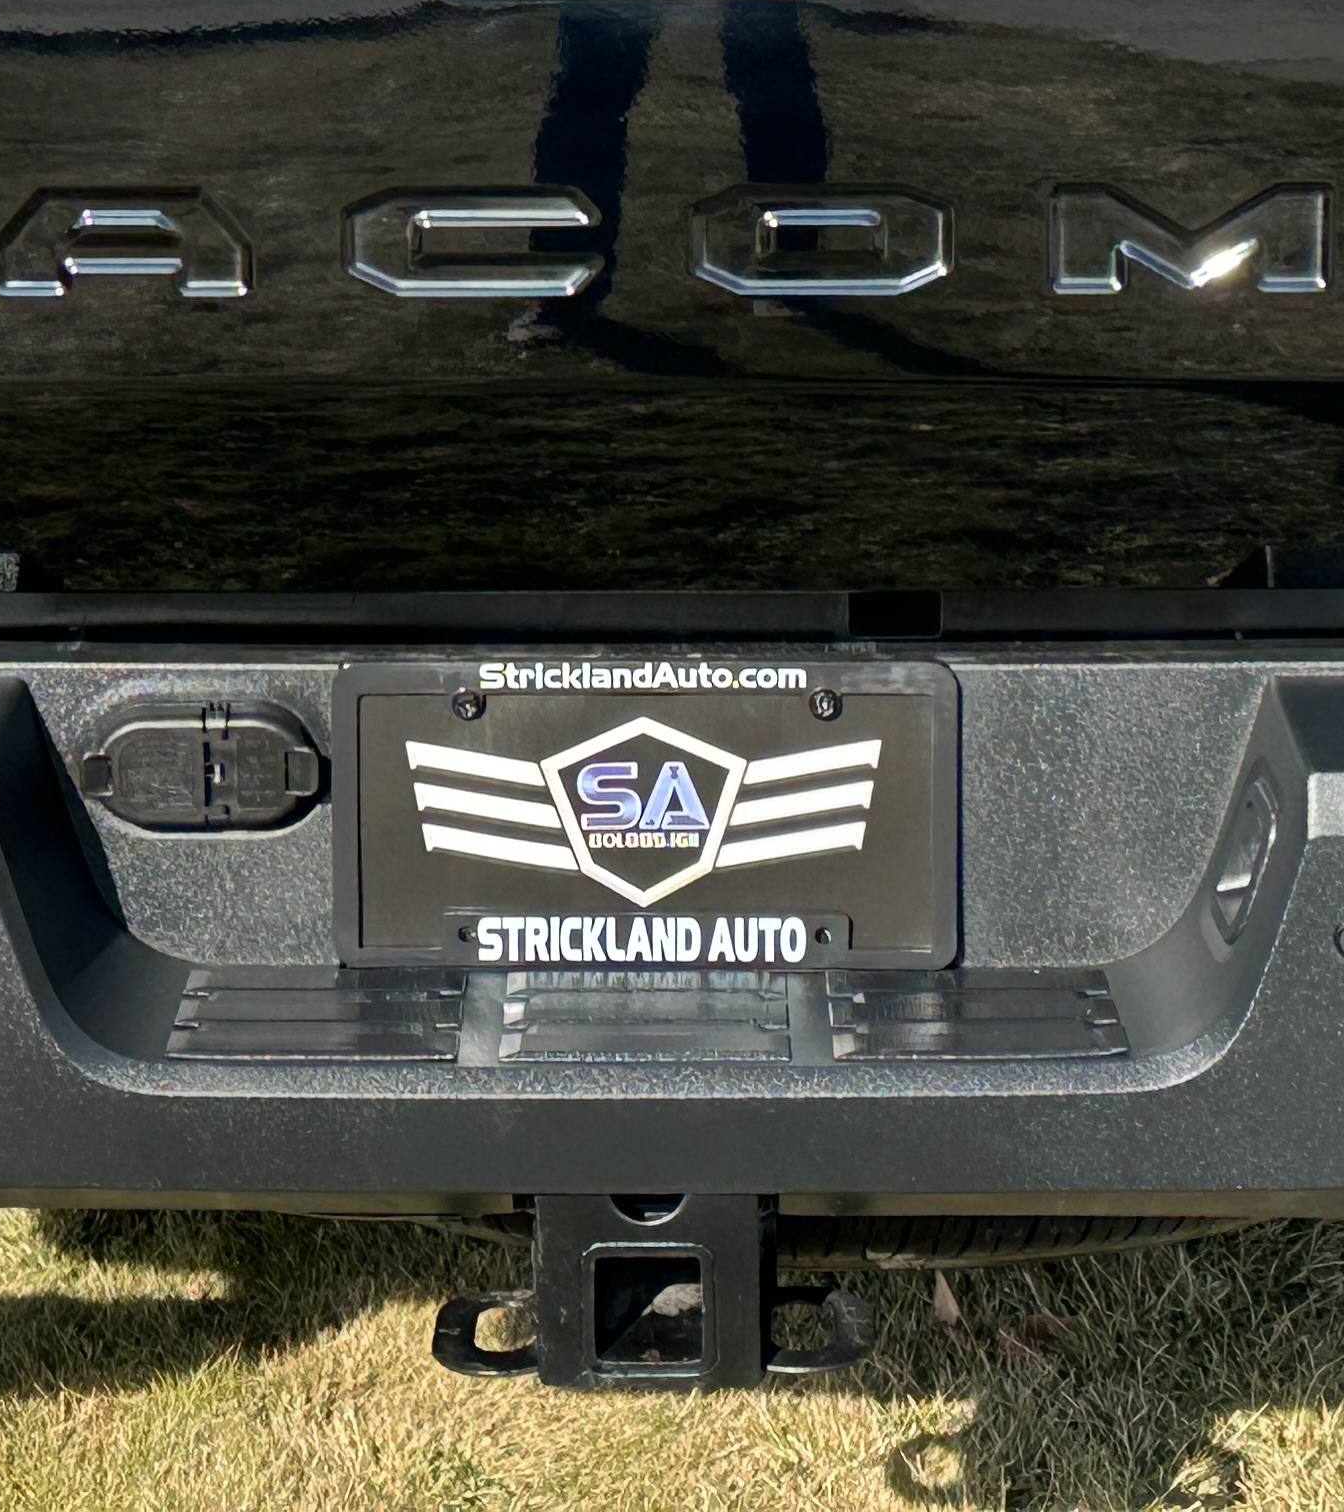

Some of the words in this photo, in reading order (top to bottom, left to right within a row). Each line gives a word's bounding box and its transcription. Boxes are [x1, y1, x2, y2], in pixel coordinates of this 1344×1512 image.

[478, 662, 808, 690] StricklandAuto.com
[576, 761, 710, 830] SA
[476, 917, 702, 963] STRICKLAND
[708, 917, 808, 963] AUTO
